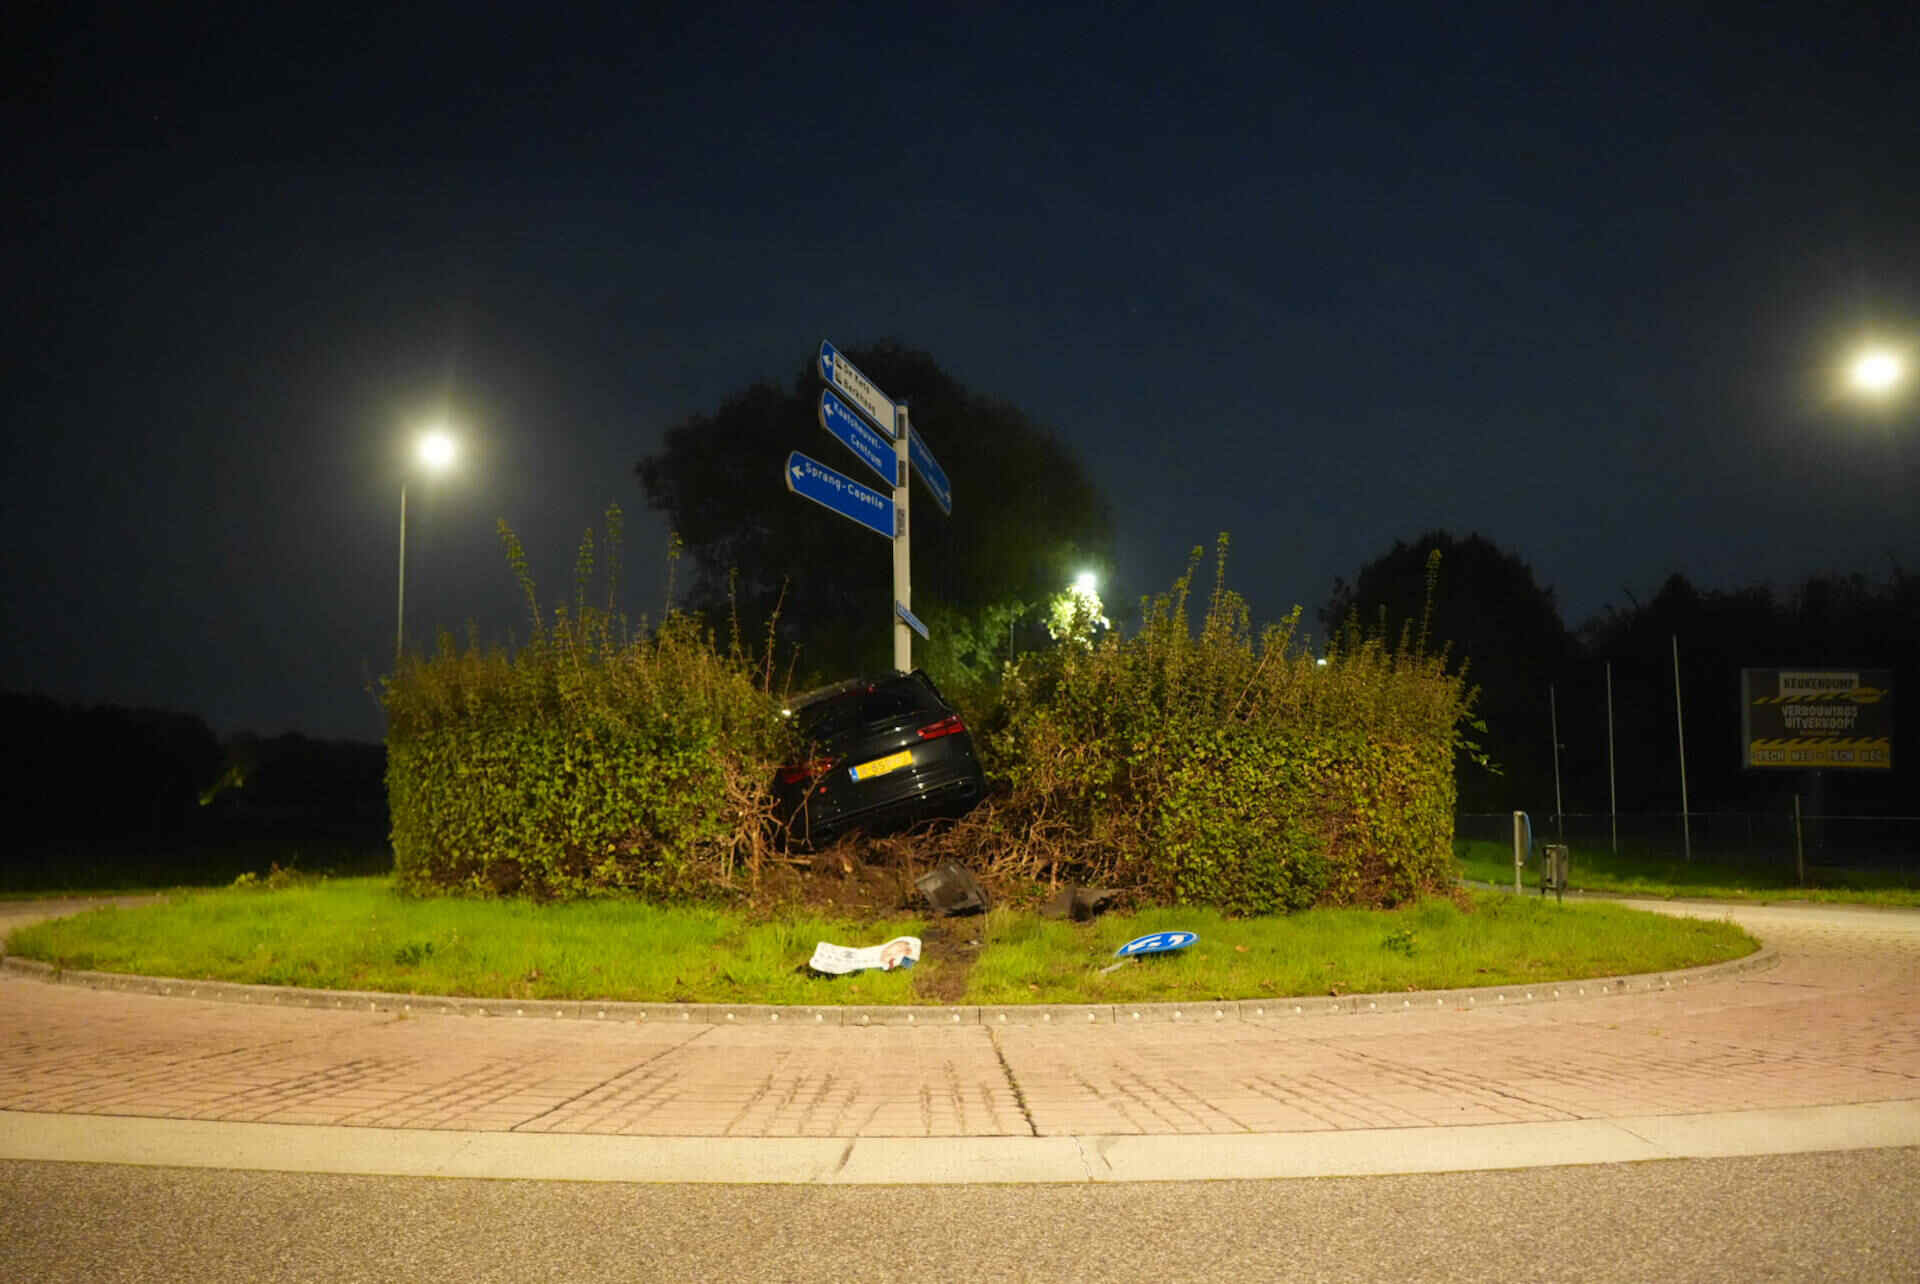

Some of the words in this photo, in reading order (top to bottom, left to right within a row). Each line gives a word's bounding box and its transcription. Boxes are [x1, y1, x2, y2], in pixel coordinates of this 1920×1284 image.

[851, 433, 882, 468] Centrum
[805, 461, 885, 510] Sprang-Capelle
[1782, 704, 1858, 717] VERBOUWINGS
